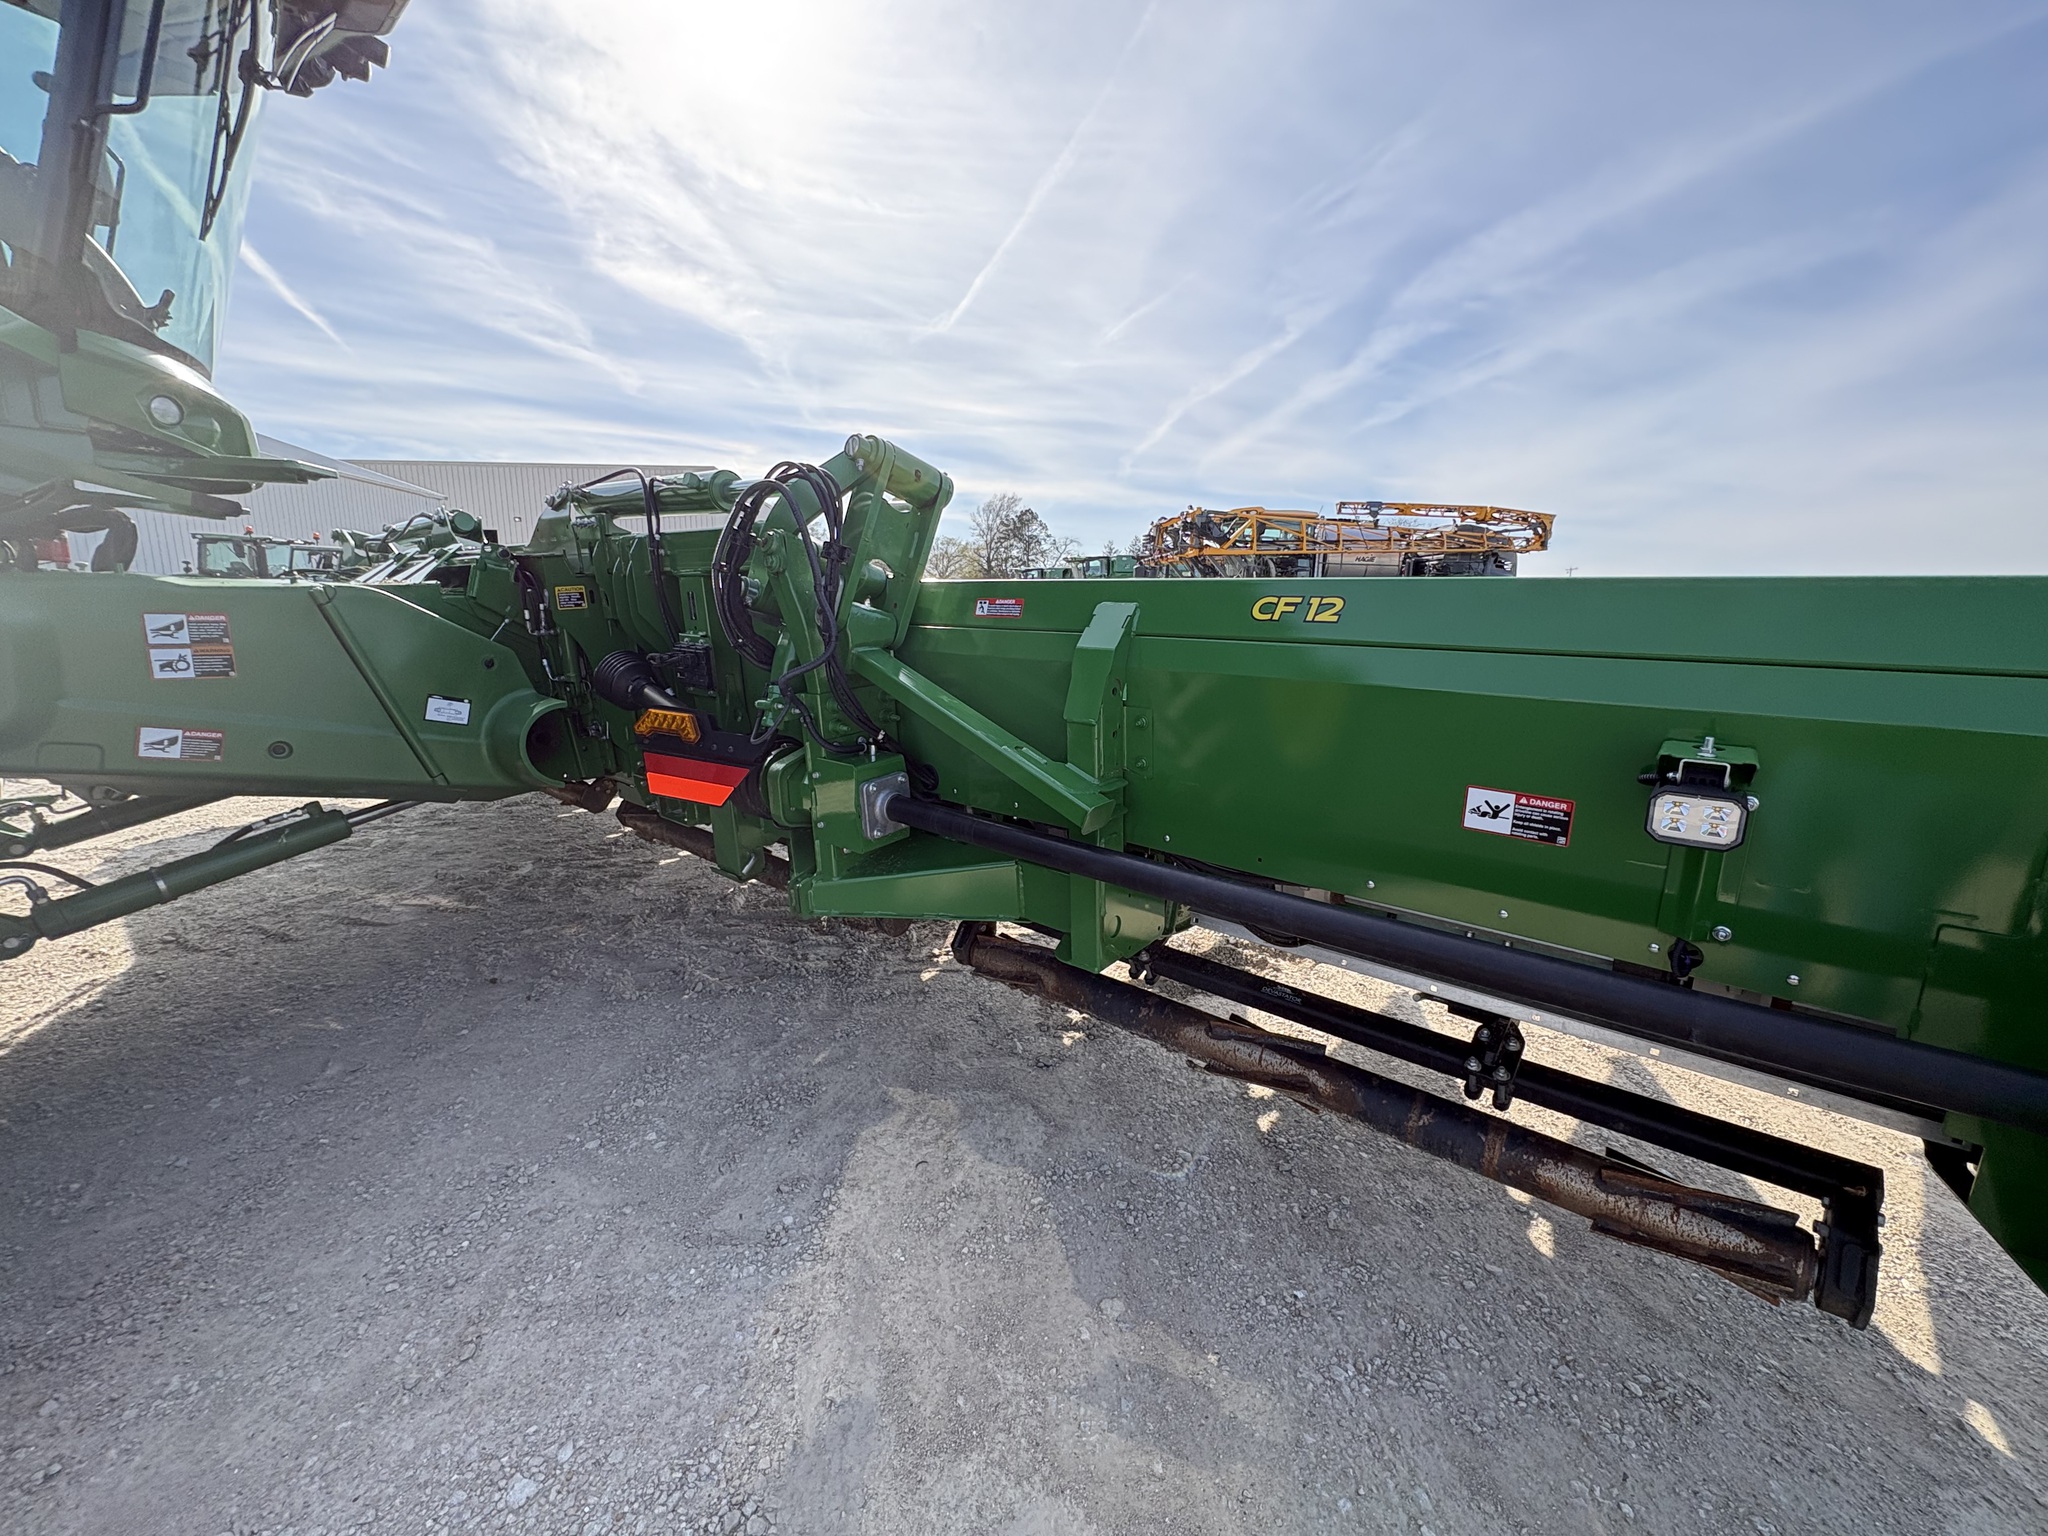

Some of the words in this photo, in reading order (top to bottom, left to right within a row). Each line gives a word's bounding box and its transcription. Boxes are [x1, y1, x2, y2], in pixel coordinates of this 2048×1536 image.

[1251, 595, 1305, 622] CF
[1303, 596, 1346, 623] 12
[1530, 798, 1568, 810] DANGER
[1261, 986, 1302, 1002] DEVASTATOR
